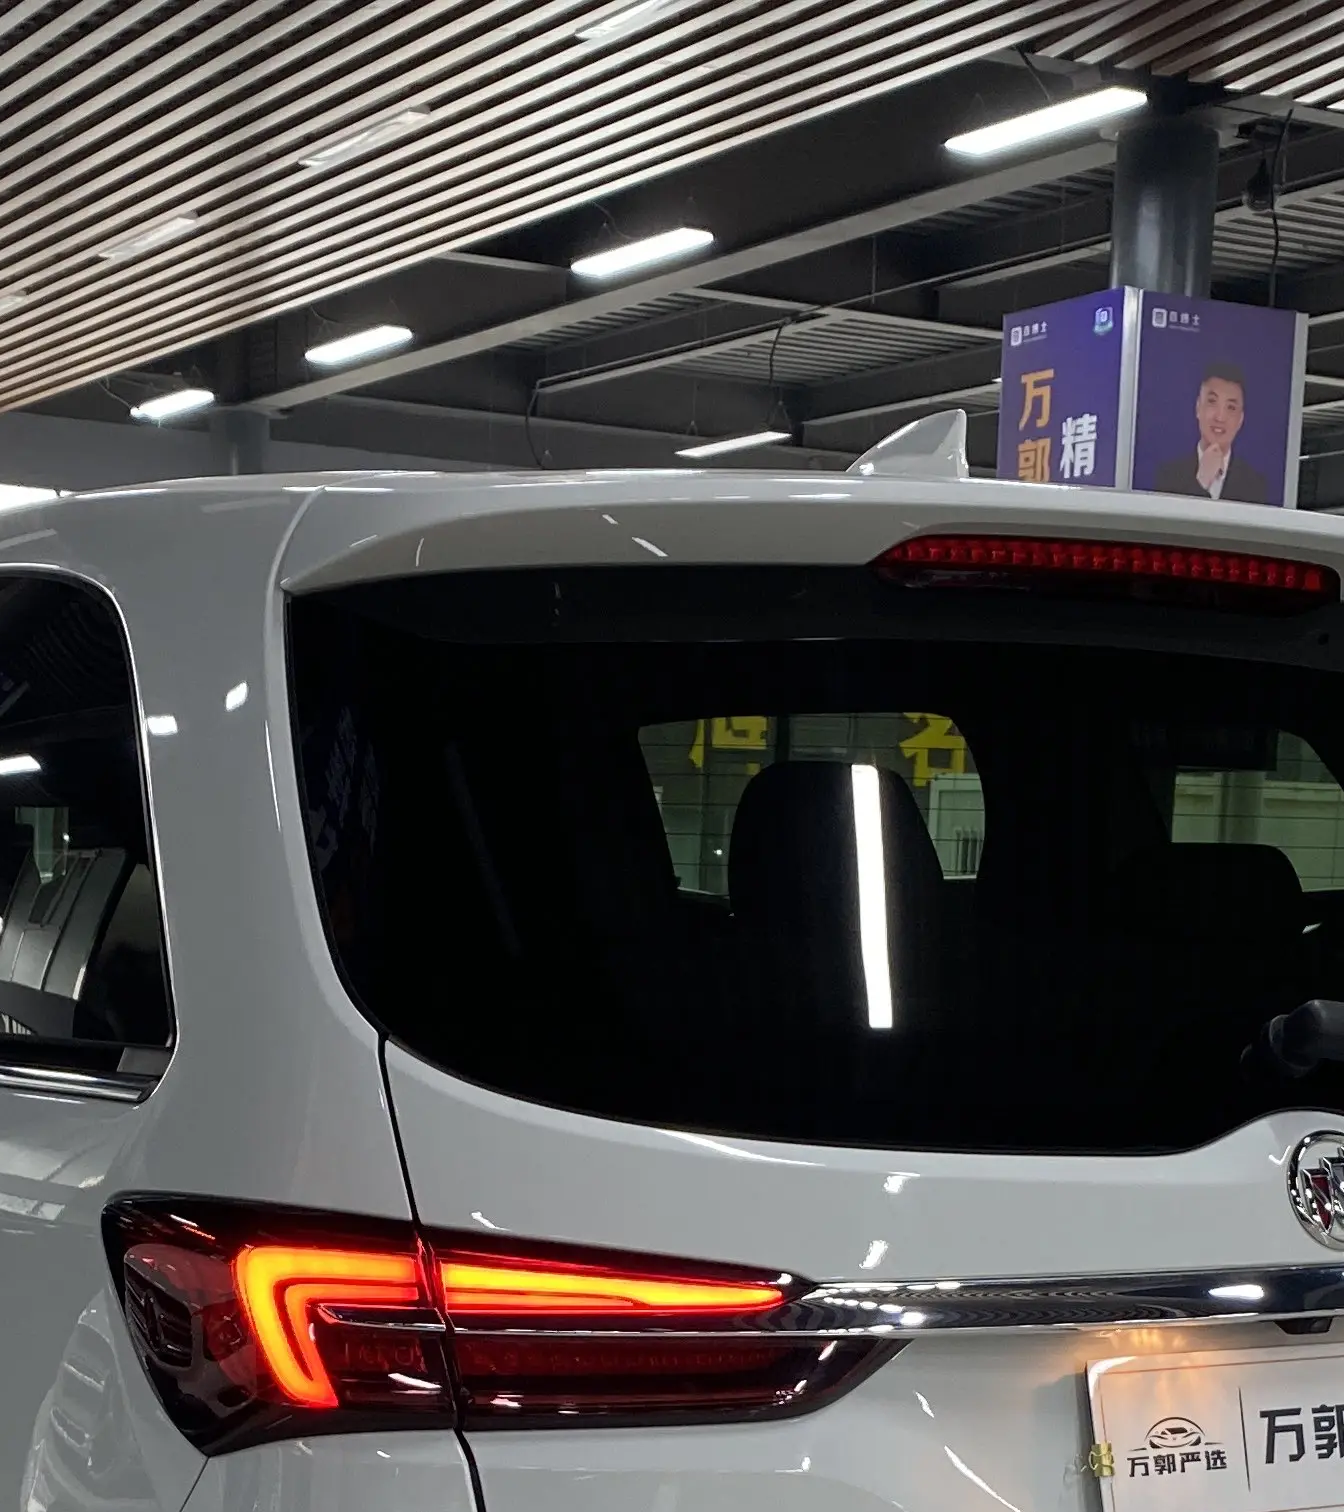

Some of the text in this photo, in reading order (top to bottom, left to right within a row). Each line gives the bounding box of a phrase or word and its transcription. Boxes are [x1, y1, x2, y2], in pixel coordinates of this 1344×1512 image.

[1017, 368, 1054, 482] 万郭
[1059, 413, 1097, 478] 精
[1126, 1449, 1228, 1477] 万郭严选
